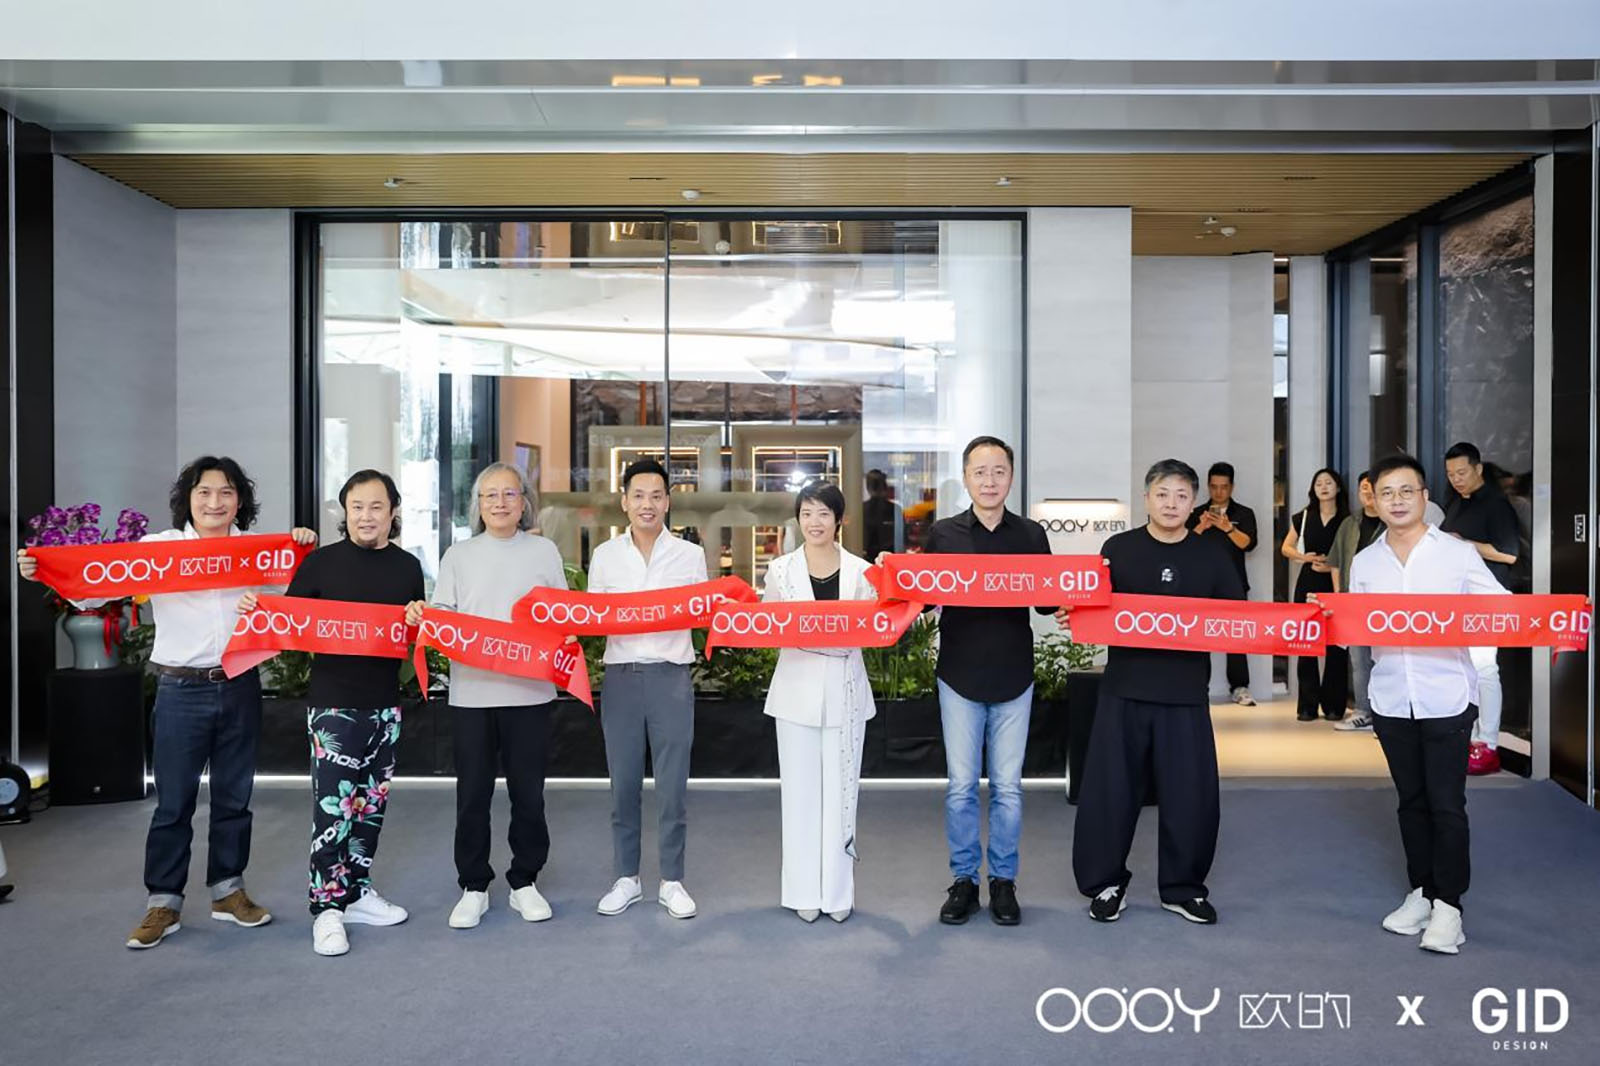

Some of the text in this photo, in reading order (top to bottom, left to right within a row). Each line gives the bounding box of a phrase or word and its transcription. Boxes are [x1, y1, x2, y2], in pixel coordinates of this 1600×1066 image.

[256, 549, 295, 570] GID
[1059, 570, 1099, 591] GID
[390, 622, 408, 643] GI
[1281, 619, 1321, 641] GID
[1549, 610, 1592, 634] GID
